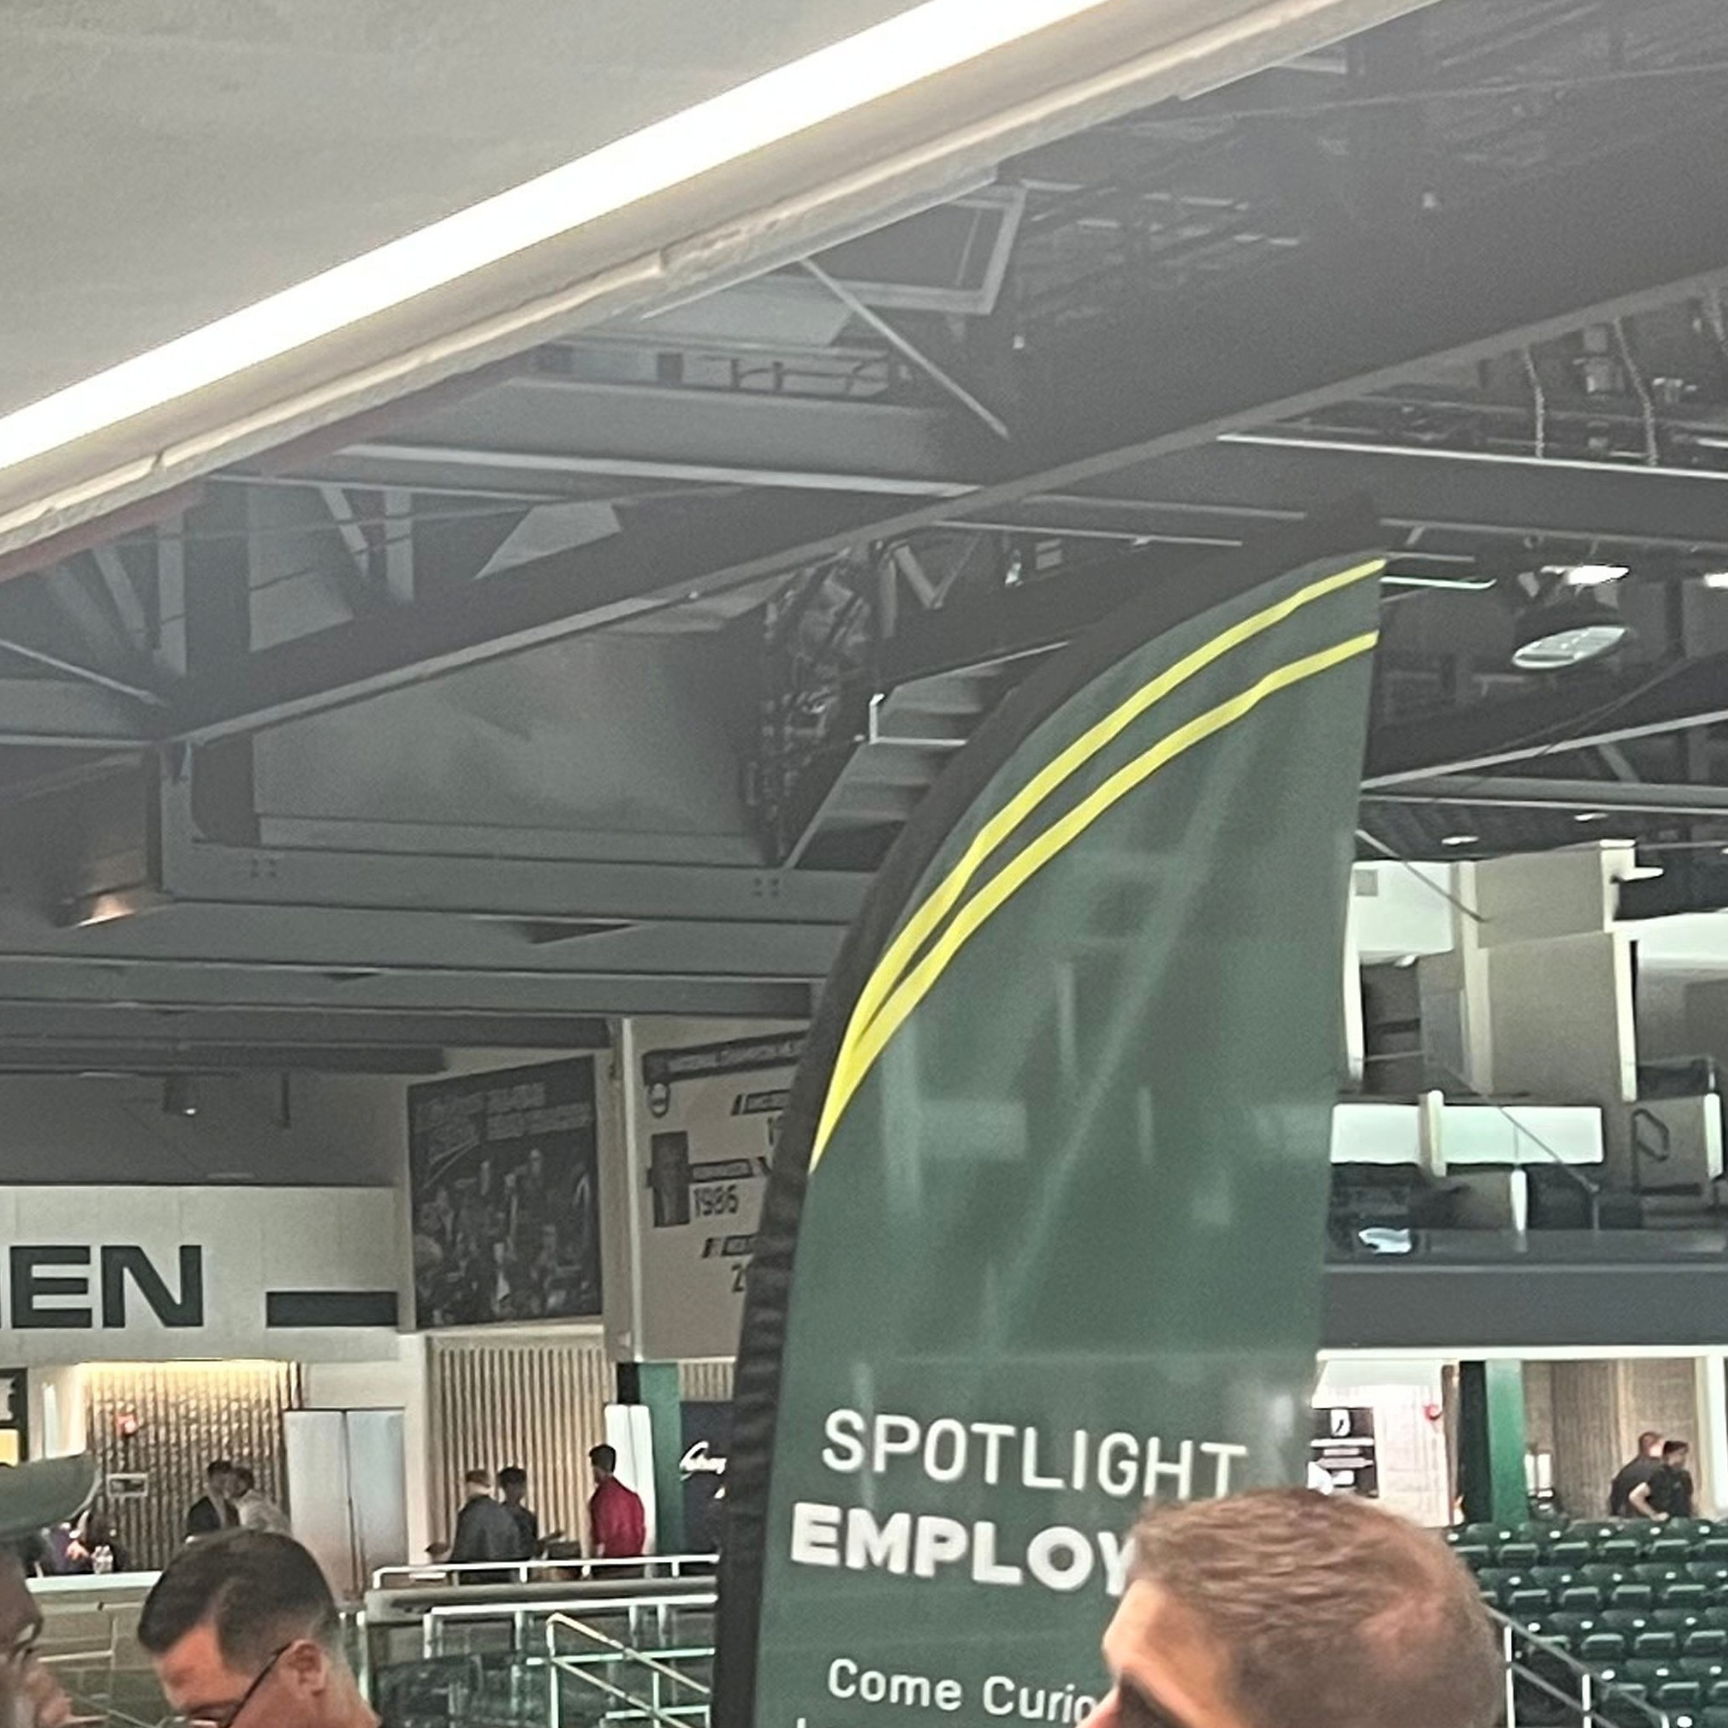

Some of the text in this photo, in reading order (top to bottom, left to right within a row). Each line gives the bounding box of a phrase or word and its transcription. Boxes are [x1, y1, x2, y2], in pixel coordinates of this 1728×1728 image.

[821, 1408, 1249, 1500] SPOTLIGHT
[790, 1501, 1136, 1597] EMPLOY
[828, 1657, 1099, 1724] Come Curio
